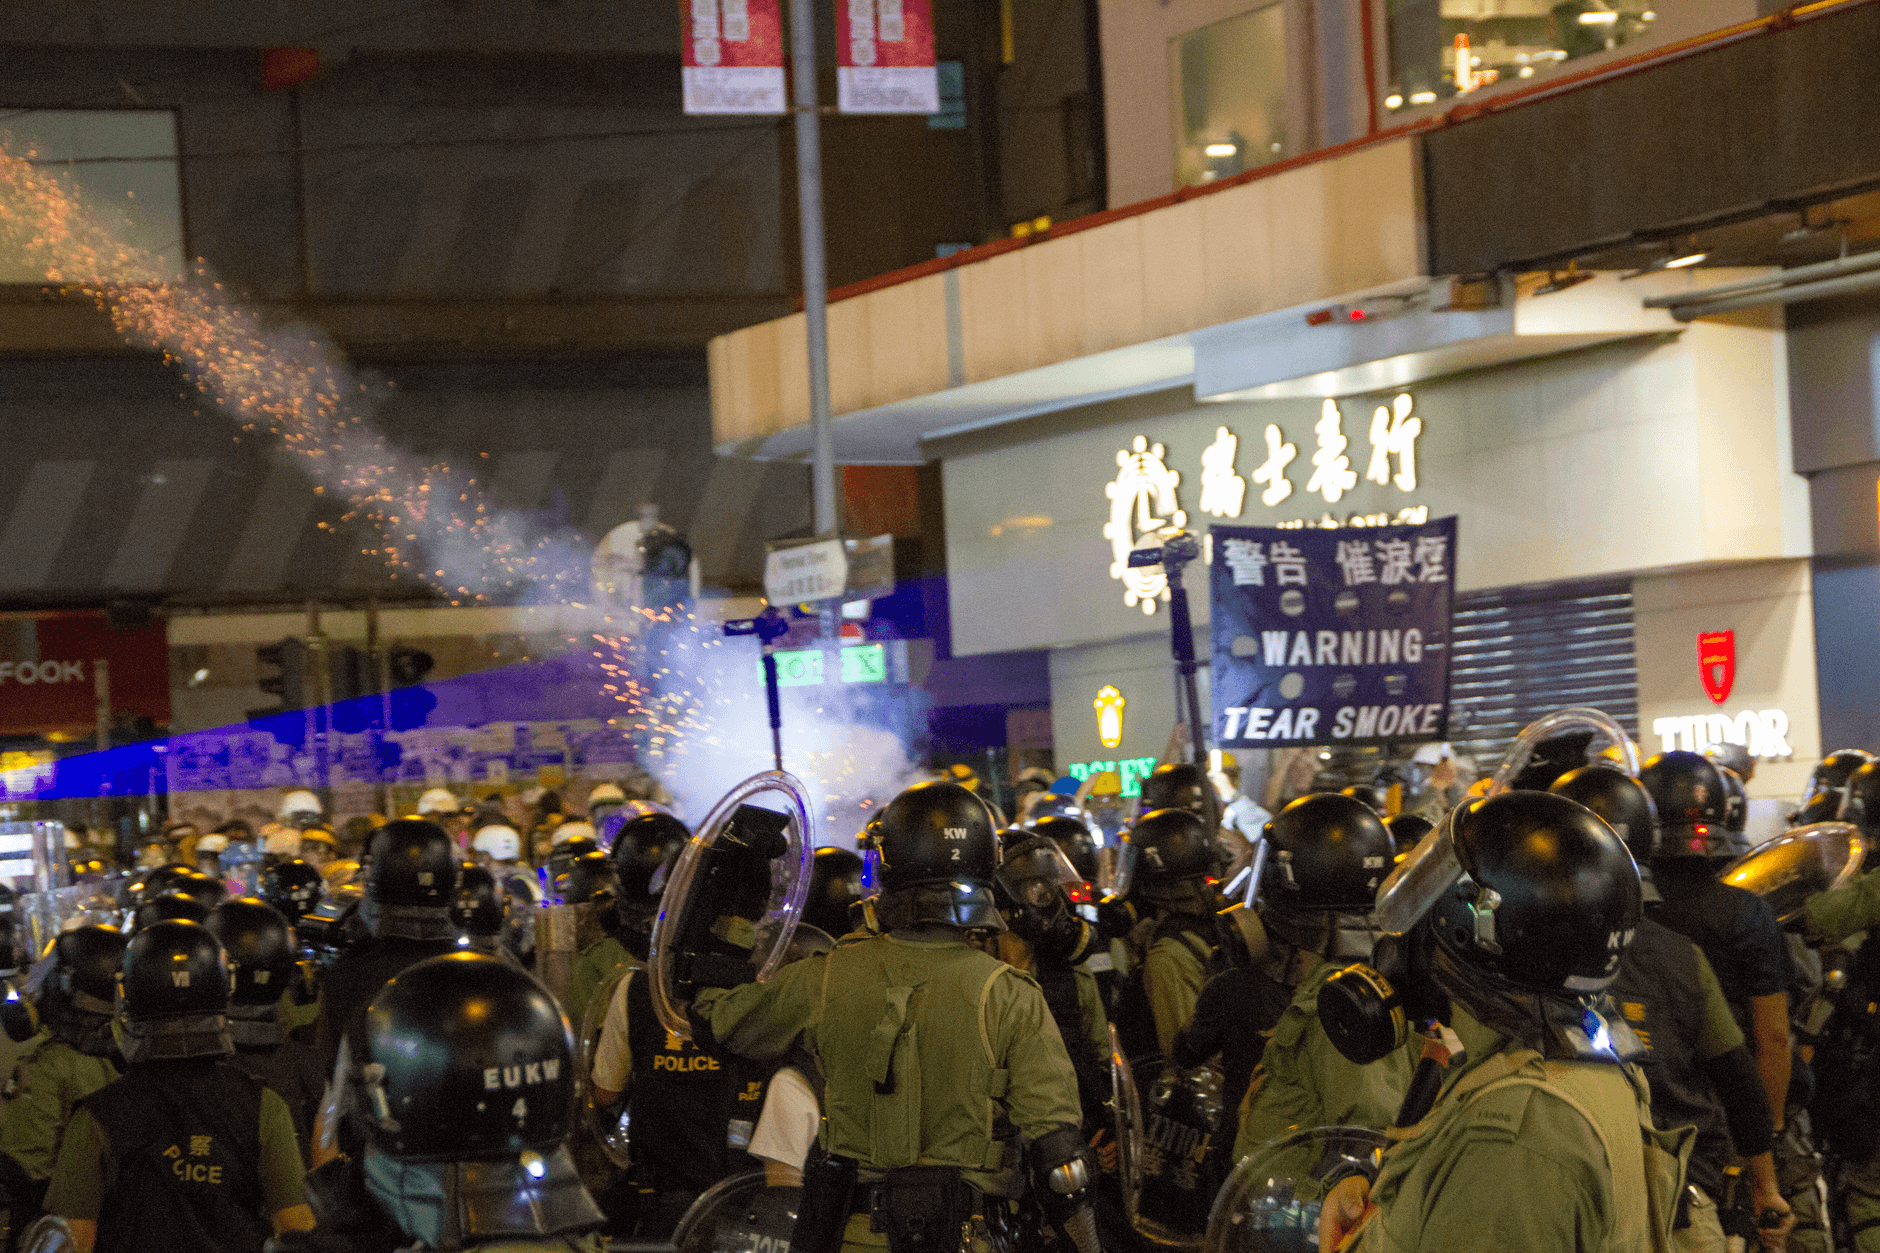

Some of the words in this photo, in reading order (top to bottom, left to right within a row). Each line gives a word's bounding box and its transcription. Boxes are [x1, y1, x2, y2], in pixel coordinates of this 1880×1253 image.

[1223, 537, 1307, 586] 警告
[1262, 628, 1423, 667] WARNING
[0, 660, 85, 684] FOOK
[1224, 706, 1320, 740] TEAR
[1331, 703, 1443, 738] SMOKE
[1653, 709, 1793, 757] TUDOR
[943, 827, 967, 840] KW
[950, 848, 960, 860] 2
[1607, 927, 1635, 949] KW
[1604, 954, 1619, 971] 2
[483, 1058, 561, 1090] EUKW
[653, 1054, 721, 1073] POLICE
[512, 1097, 528, 1118] 4
